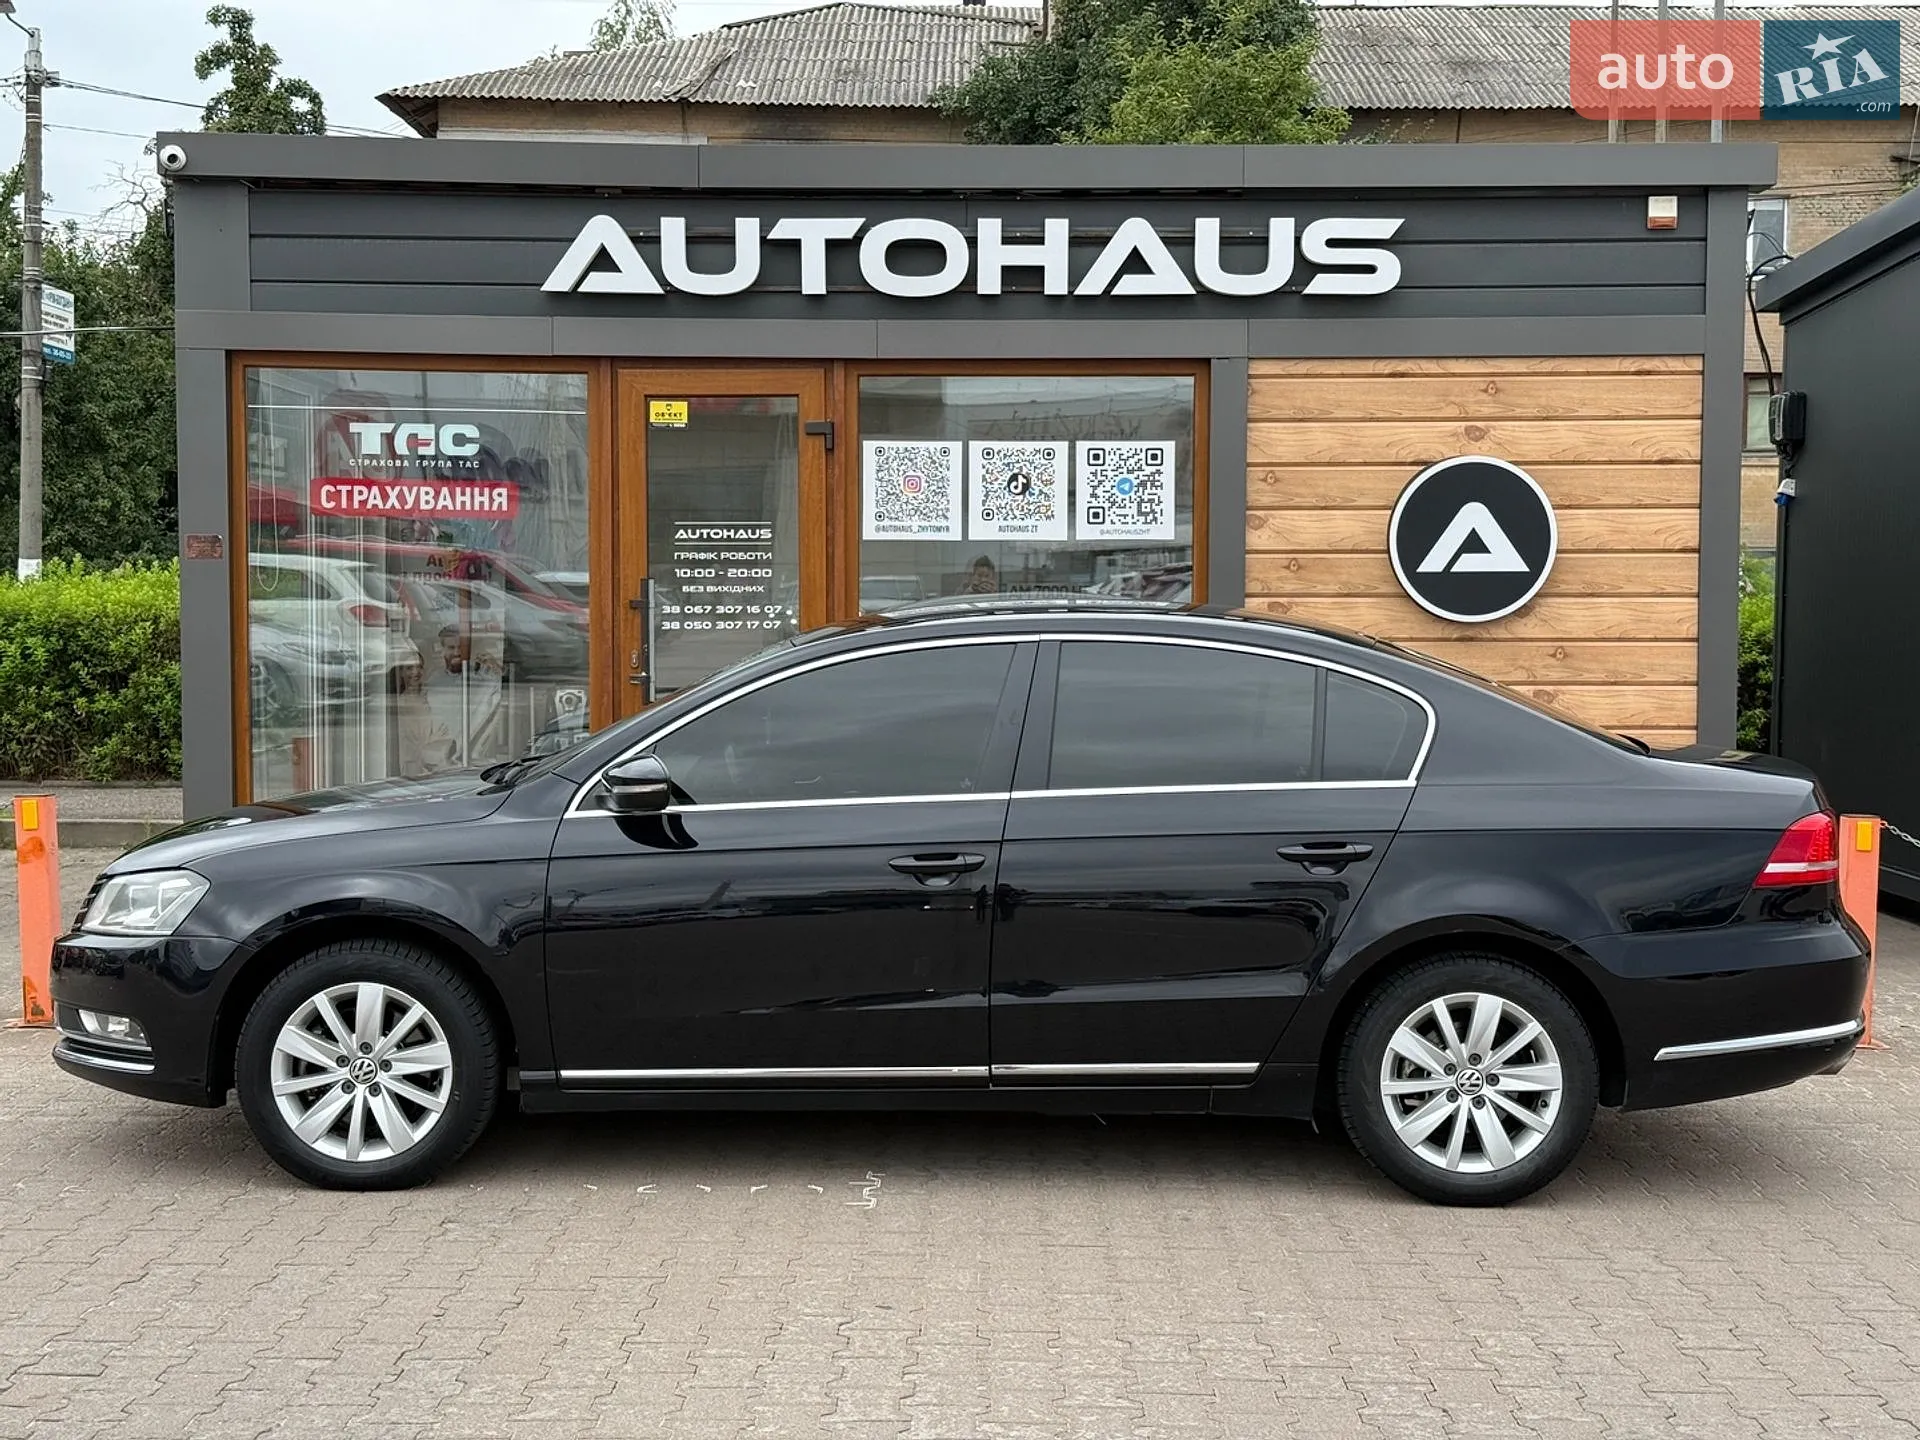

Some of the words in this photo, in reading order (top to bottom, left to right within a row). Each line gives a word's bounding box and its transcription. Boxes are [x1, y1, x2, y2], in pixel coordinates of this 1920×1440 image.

[541, 213, 1406, 298] AUTOHAUS
[349, 422, 480, 456] ТАС
[349, 458, 409, 468] СТРАХОВА
[416, 459, 452, 468] ГРУПА
[459, 460, 480, 468] ТАС
[320, 484, 508, 512] СТРАХУВАННЯ
[674, 528, 773, 539] AUTOHAUS
[674, 552, 718, 560] ГРАФІК
[721, 552, 772, 560] РОБОТИ
[674, 568, 716, 578] 10:00
[727, 568, 773, 578] 20:00
[682, 585, 704, 593] БЕЗ
[706, 585, 765, 593] ВИХІДНИХ
[661, 605, 681, 614] 38
[683, 605, 713, 614] 067
[715, 605, 743, 614] 307
[746, 605, 760, 614] 16
[763, 604, 783, 614] 07
[661, 621, 681, 630] 38
[683, 621, 713, 630] 050
[715, 621, 743, 630] 307
[746, 621, 760, 630] 17
[762, 620, 782, 630] 07
